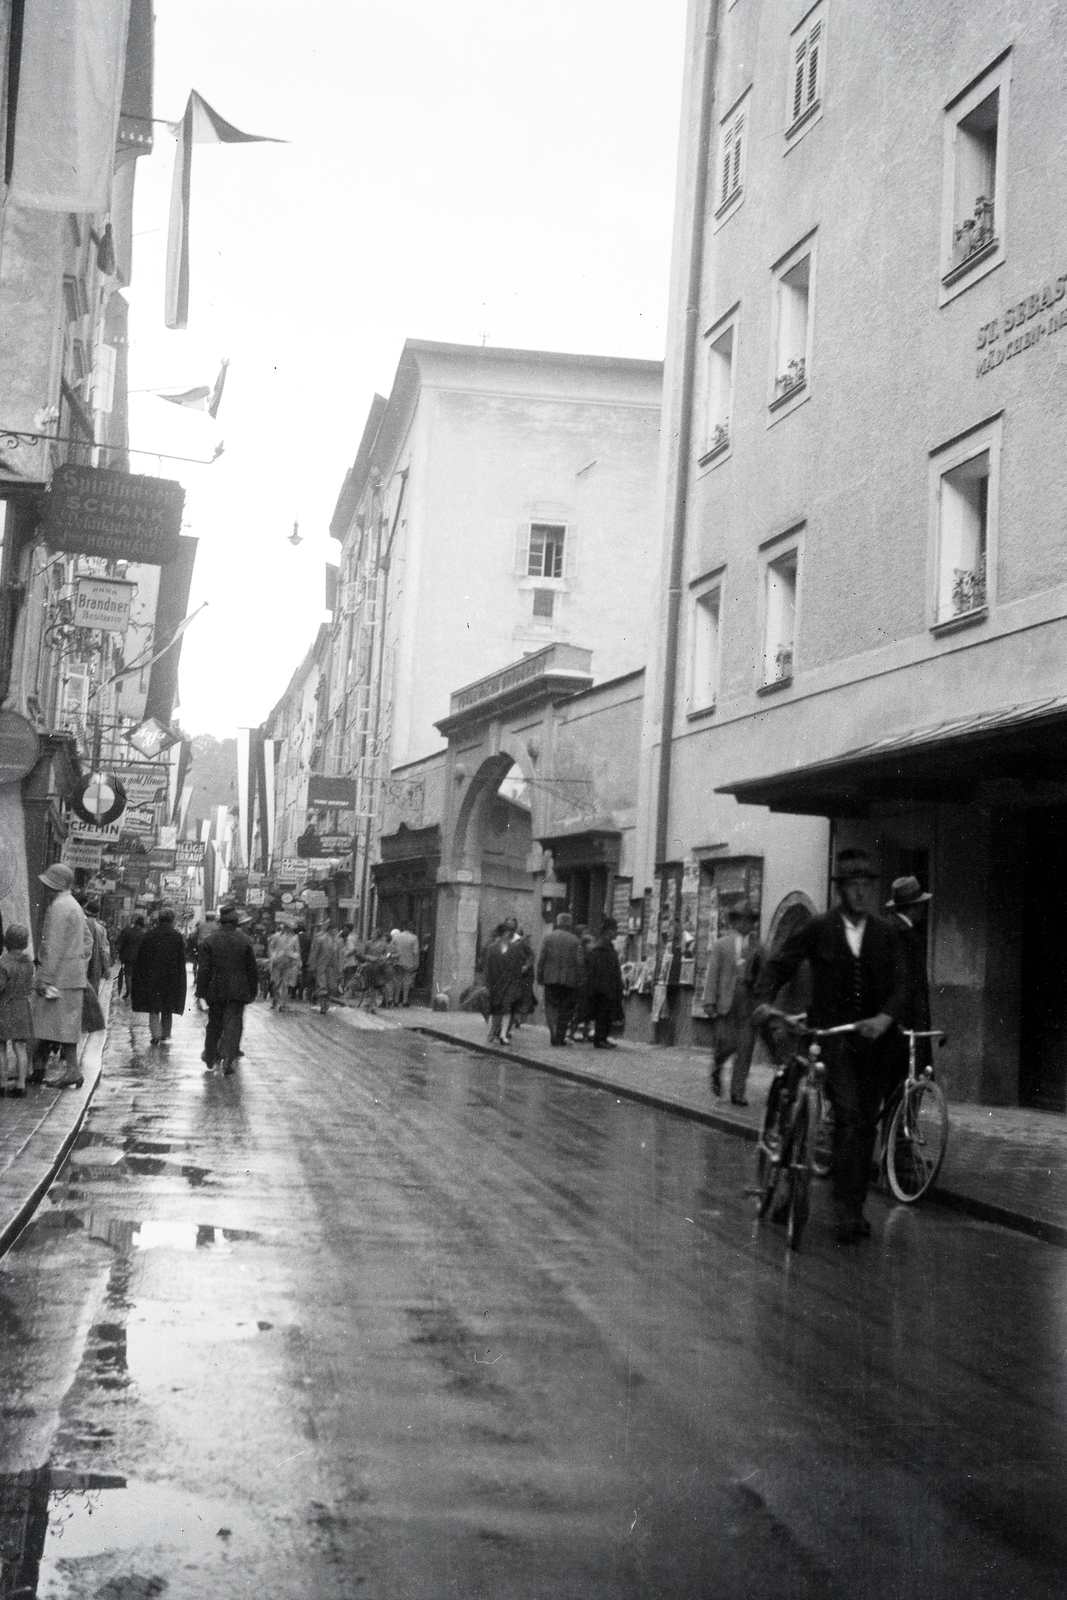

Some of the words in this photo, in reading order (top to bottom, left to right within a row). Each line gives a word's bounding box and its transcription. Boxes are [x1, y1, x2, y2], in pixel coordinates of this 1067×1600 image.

[67, 496, 166, 521] SCHANK
[78, 593, 129, 613] Brandner
[130, 727, 166, 748] Agfa
[175, 852, 204, 863] ERKAUF
